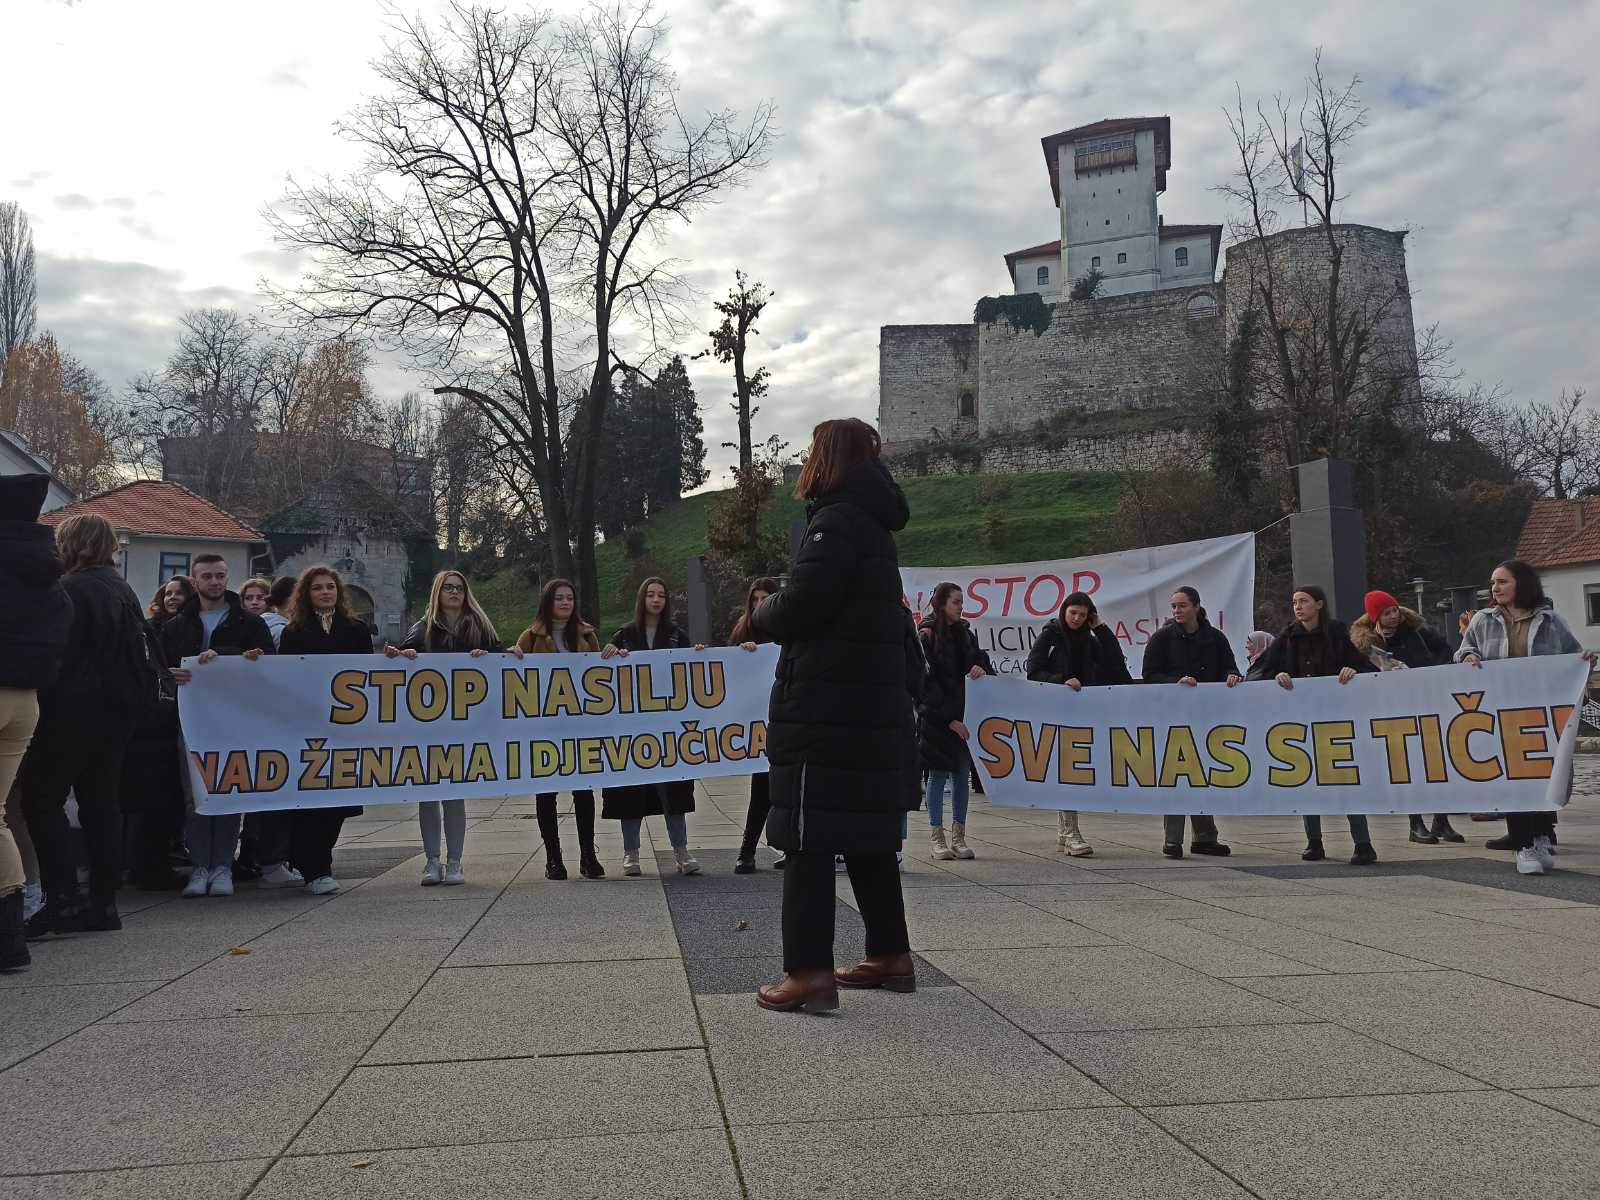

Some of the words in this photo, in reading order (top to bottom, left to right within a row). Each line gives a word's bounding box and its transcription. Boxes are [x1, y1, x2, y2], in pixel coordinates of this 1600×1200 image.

[962, 570, 1101, 619] STOP
[329, 668, 489, 725] STOP
[501, 661, 726, 720] NASILJU
[190, 749, 290, 795] NAD
[297, 737, 498, 792] ŽENAMA
[506, 741, 521, 780] I
[976, 716, 1096, 787] SVE
[1109, 725, 1252, 788] NAS
[1265, 719, 1361, 788] SE
